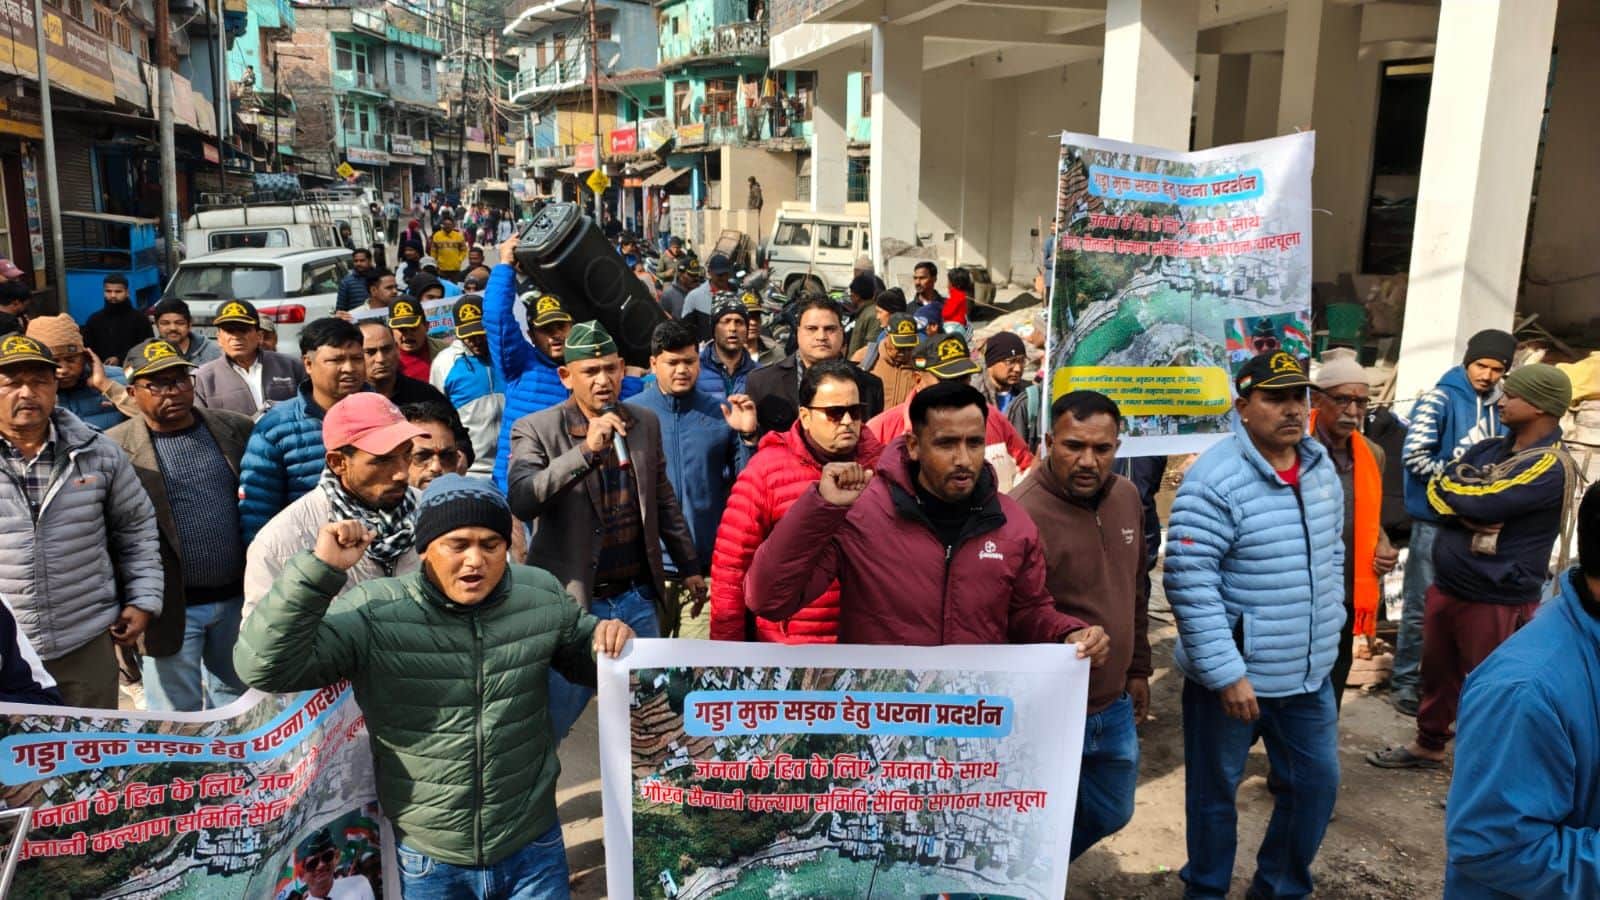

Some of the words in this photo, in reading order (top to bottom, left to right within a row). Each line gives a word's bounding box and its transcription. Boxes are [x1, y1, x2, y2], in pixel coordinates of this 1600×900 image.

[1178, 183, 1208, 198] धरना
[1211, 174, 1257, 196] प्रदर्शन
[1232, 215, 1263, 232] साथ
[1256, 232, 1301, 251] धारचूला
[694, 701, 733, 732] गड्डा
[736, 701, 779, 729] मुक्त
[782, 701, 837, 726] सड़क
[841, 695, 872, 729] हेतु
[875, 702, 931, 724] धरना
[935, 699, 1004, 726] प्रदर्शन
[12, 741, 67, 774] गड्डा
[72, 739, 130, 764] मुक्त
[134, 740, 204, 757] सड़क
[209, 739, 248, 759] हेतु
[252, 709, 304, 752] धरना
[694, 759, 748, 781] जनता
[751, 755, 770, 780] के
[774, 754, 807, 780] हित
[810, 753, 829, 779] के
[833, 753, 875, 782] लिए,
[879, 760, 931, 780] जनता
[936, 756, 955, 780] के
[958, 761, 1000, 779] साथ
[94, 788, 120, 816] के
[125, 782, 166, 810] हित
[169, 777, 194, 802] के
[200, 772, 250, 798] लिए,
[642, 780, 683, 805] गौरव
[687, 785, 745, 811] सैनानी
[748, 793, 810, 813] कल्याण
[814, 787, 868, 813] समिति
[872, 789, 924, 814] सैनिक
[985, 789, 1048, 813] धारचूला
[92, 815, 173, 852] कल्याण
[176, 803, 243, 832] समिति
